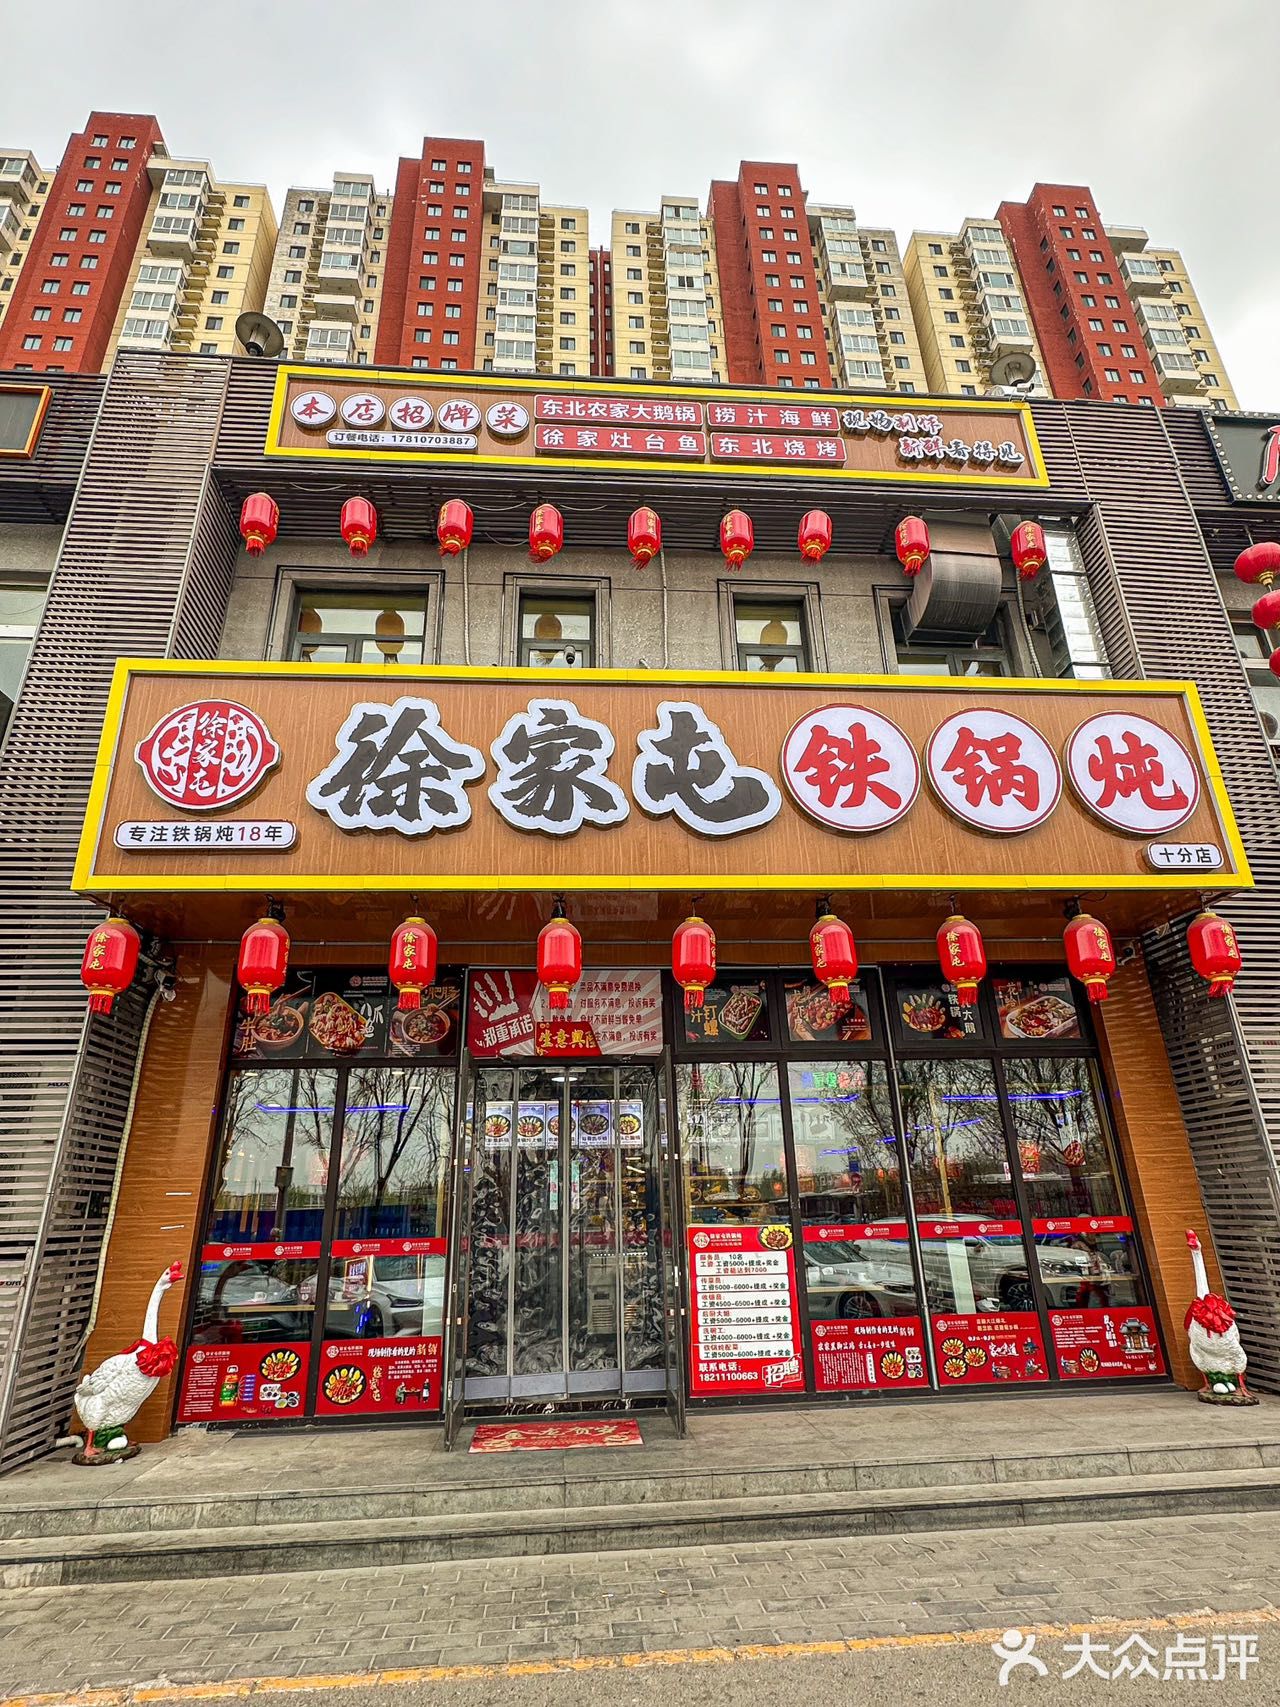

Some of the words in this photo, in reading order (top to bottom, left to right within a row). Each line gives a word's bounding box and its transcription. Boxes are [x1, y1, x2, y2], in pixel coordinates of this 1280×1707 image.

[297, 395, 521, 431] 本店招牌菜
[542, 399, 696, 422] 东北农家大鹅锅
[714, 407, 833, 427] 捞汁海鲜
[843, 411, 943, 434] 现场制作
[542, 428, 699, 452] 徐家灶台鱼
[719, 437, 837, 457] 东北烧烤
[900, 437, 1024, 461] 新鲜看得见
[189, 710, 228, 797] 徐家屯
[319, 707, 770, 823] 徐家屯
[794, 722, 1189, 812] 铁锅炖
[129, 825, 282, 842] 专注铁锅炖18年
[1159, 846, 1213, 864] 十分店
[88, 931, 110, 971] 徐家屯
[402, 931, 416, 971] 徐家屯
[945, 931, 965, 967] 徐家屯
[1093, 926, 1112, 962] 徐家屯
[1220, 923, 1239, 959] 徐家屯
[483, 1013, 534, 1048] 郑重承诺
[699, 1361, 742, 1372] 联系电话：
[699, 1371, 758, 1382] 18211100663
[766, 1359, 800, 1384] 招聘
